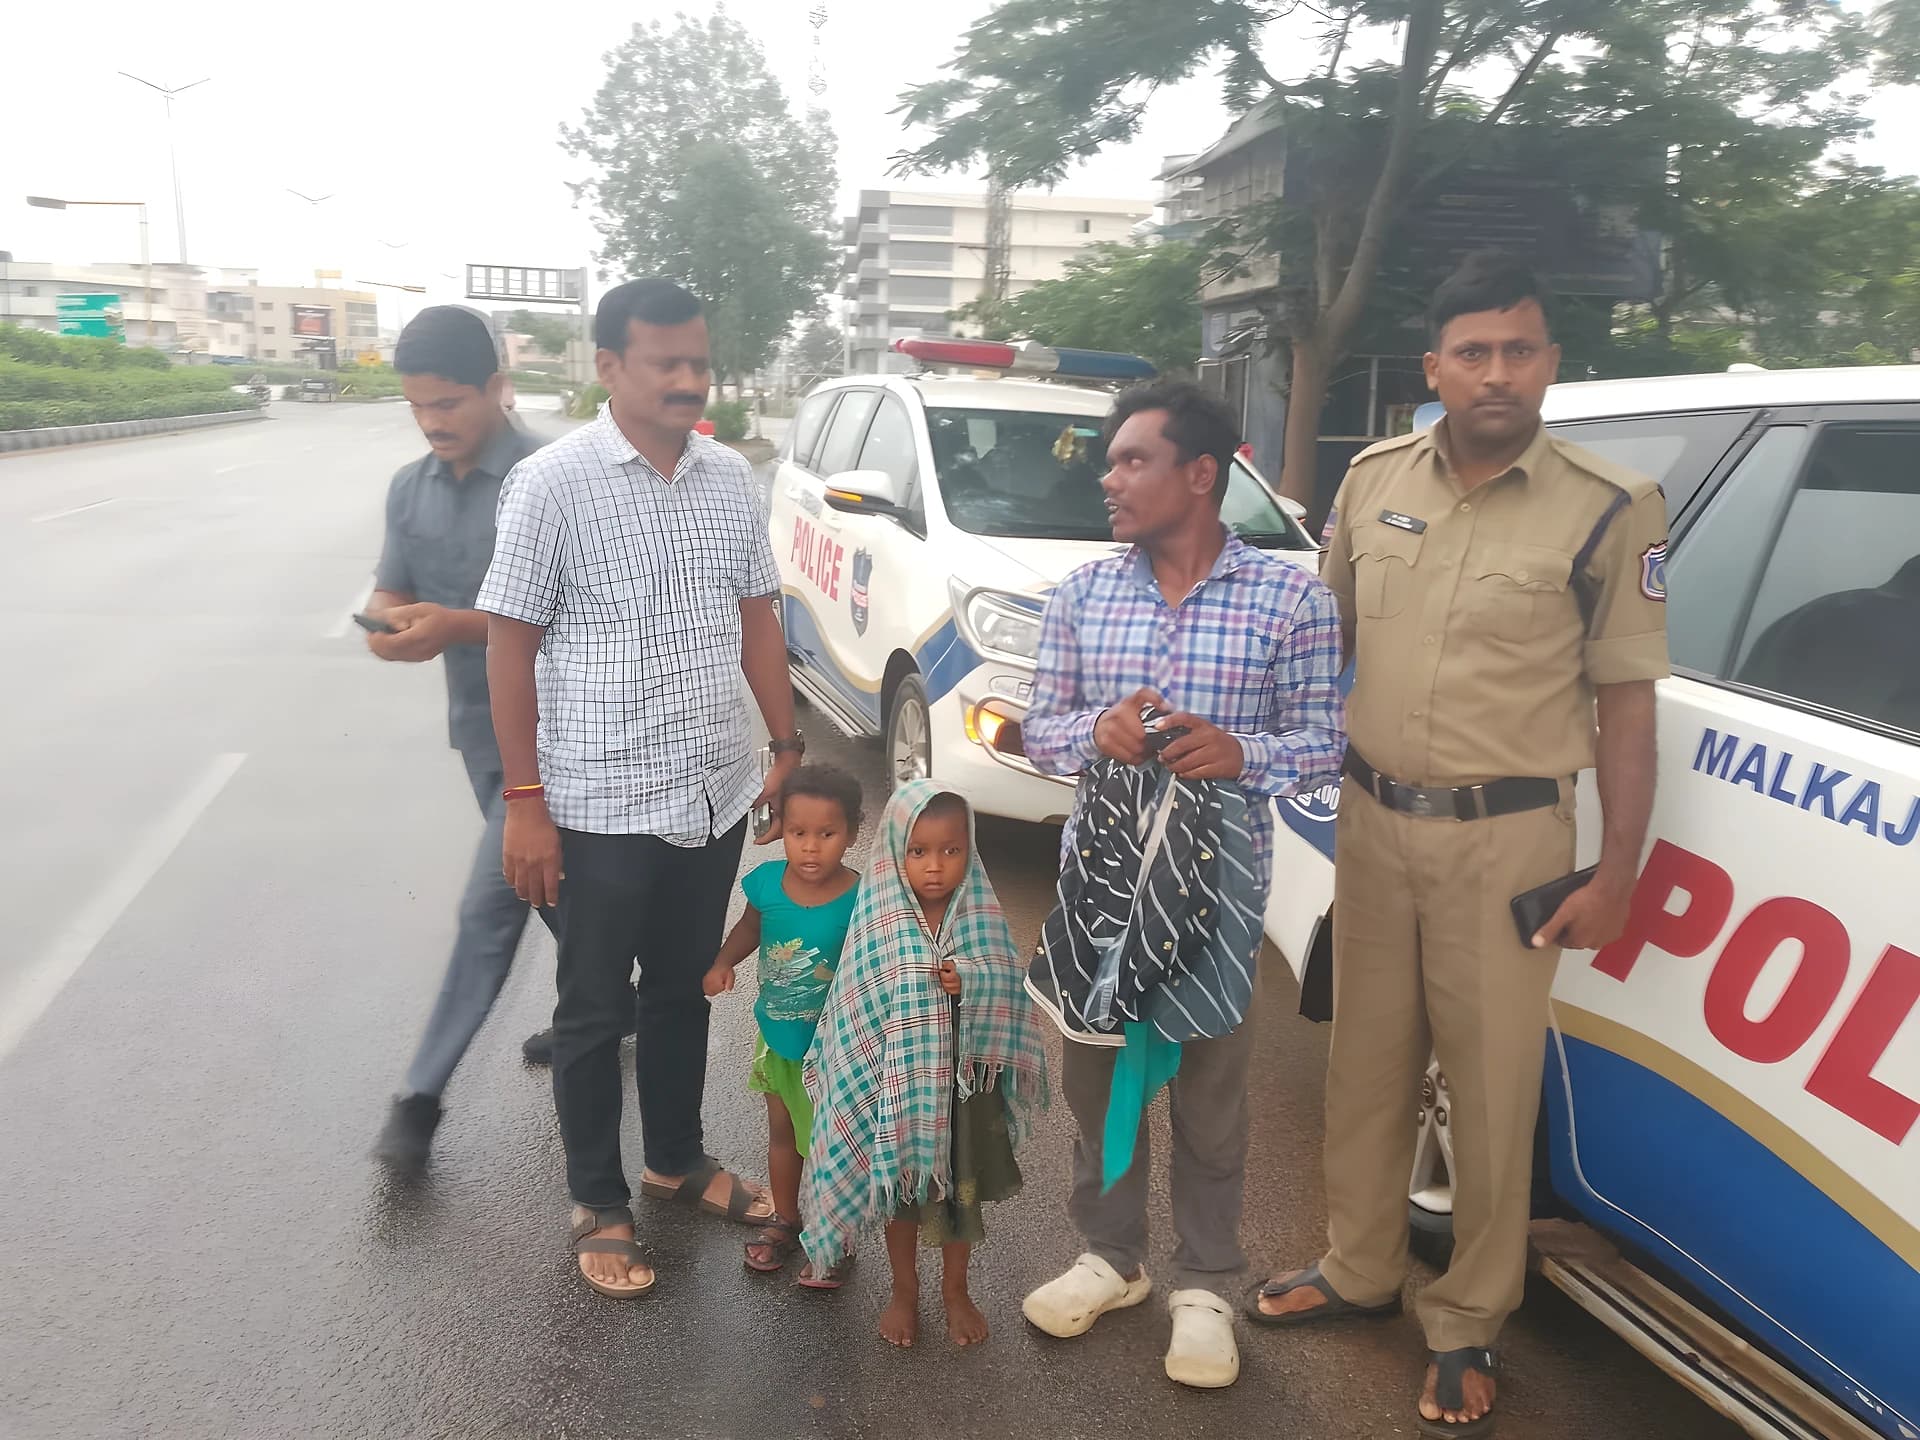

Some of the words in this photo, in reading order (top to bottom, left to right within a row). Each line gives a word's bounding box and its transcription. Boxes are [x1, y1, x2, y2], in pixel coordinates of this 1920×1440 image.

[791, 516, 844, 601] POLICE
[1693, 728, 1920, 846] MALKAJ
[1590, 838, 1920, 1146] POL
